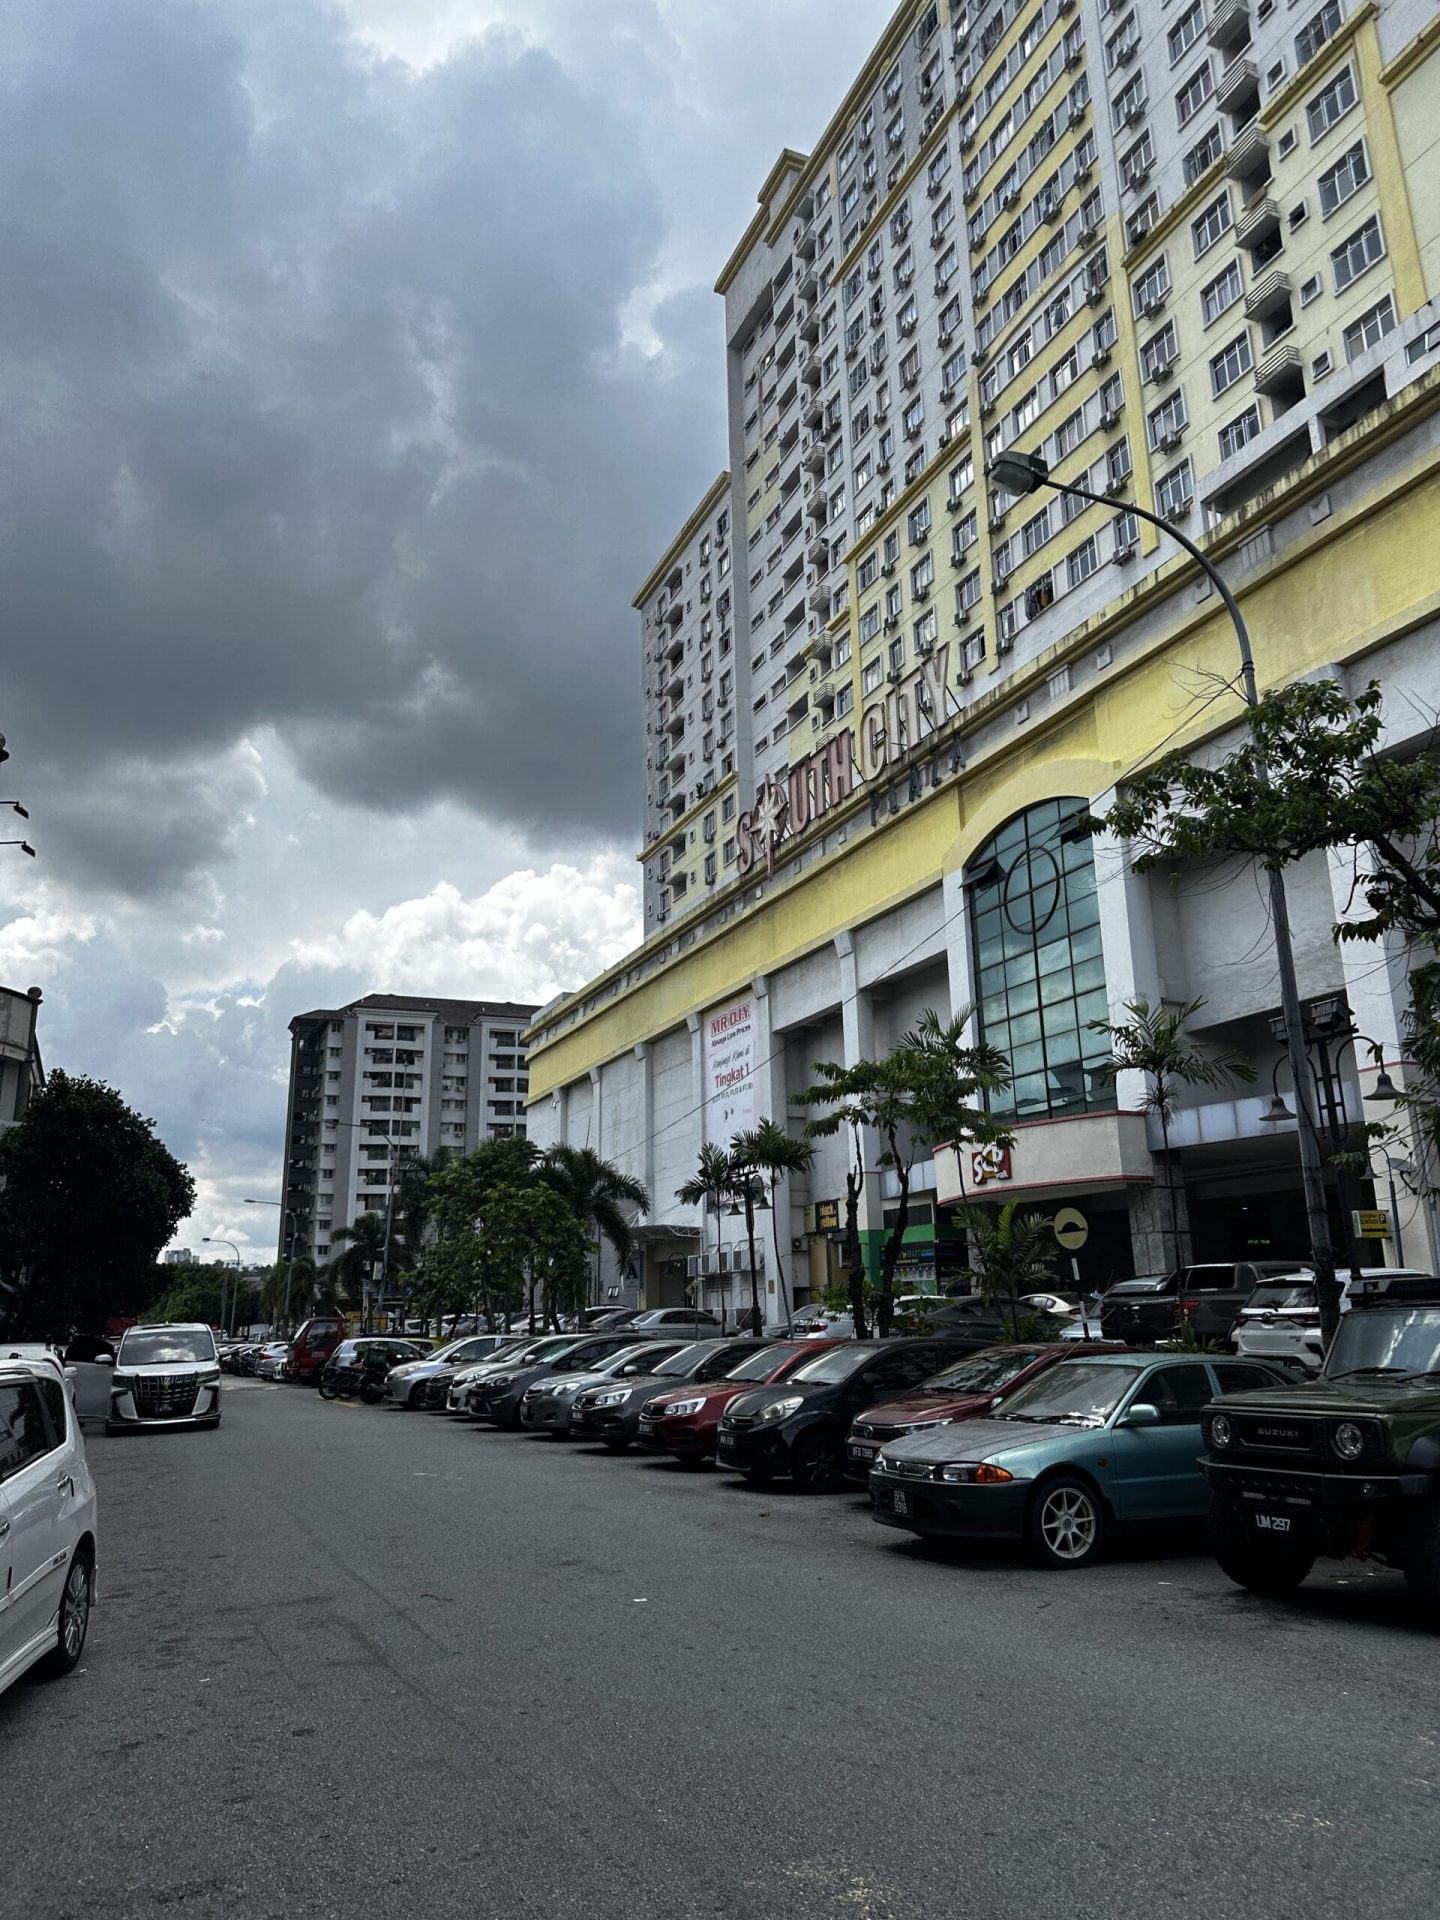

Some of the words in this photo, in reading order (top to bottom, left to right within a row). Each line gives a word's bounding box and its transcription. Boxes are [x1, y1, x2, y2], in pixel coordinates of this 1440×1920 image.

[737, 727, 853, 875] SOUTH
[860, 641, 950, 782] CITY
[869, 731, 966, 827] PLAZA
[715, 1064, 744, 1088] Tingkat
[625, 1262, 639, 1279] A
[1257, 1428, 1298, 1438] SUZUKI
[1255, 1514, 1271, 1529] UM
[1271, 1517, 1291, 1532] 297
